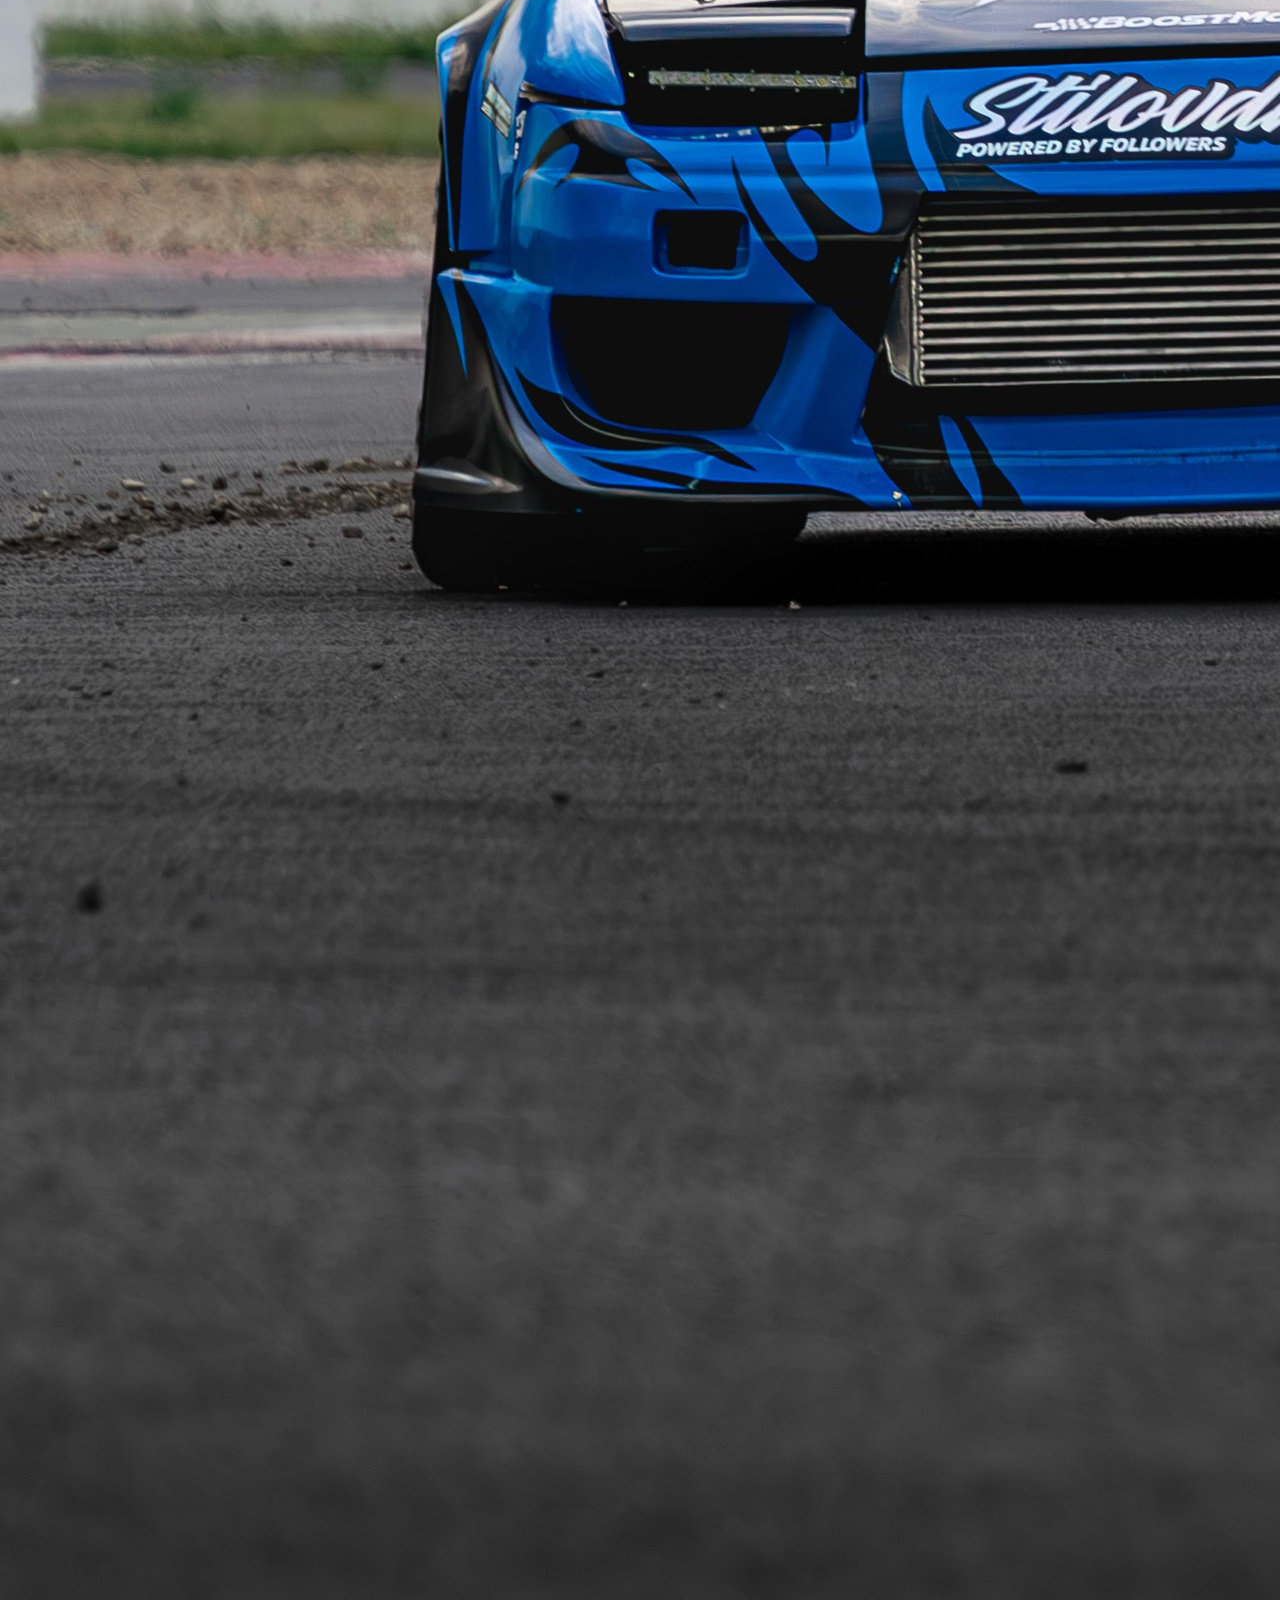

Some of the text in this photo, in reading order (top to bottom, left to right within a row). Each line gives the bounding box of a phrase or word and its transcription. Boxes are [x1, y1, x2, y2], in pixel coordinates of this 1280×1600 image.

[956, 136, 1227, 157] POWERED BY FOLLOWERS
